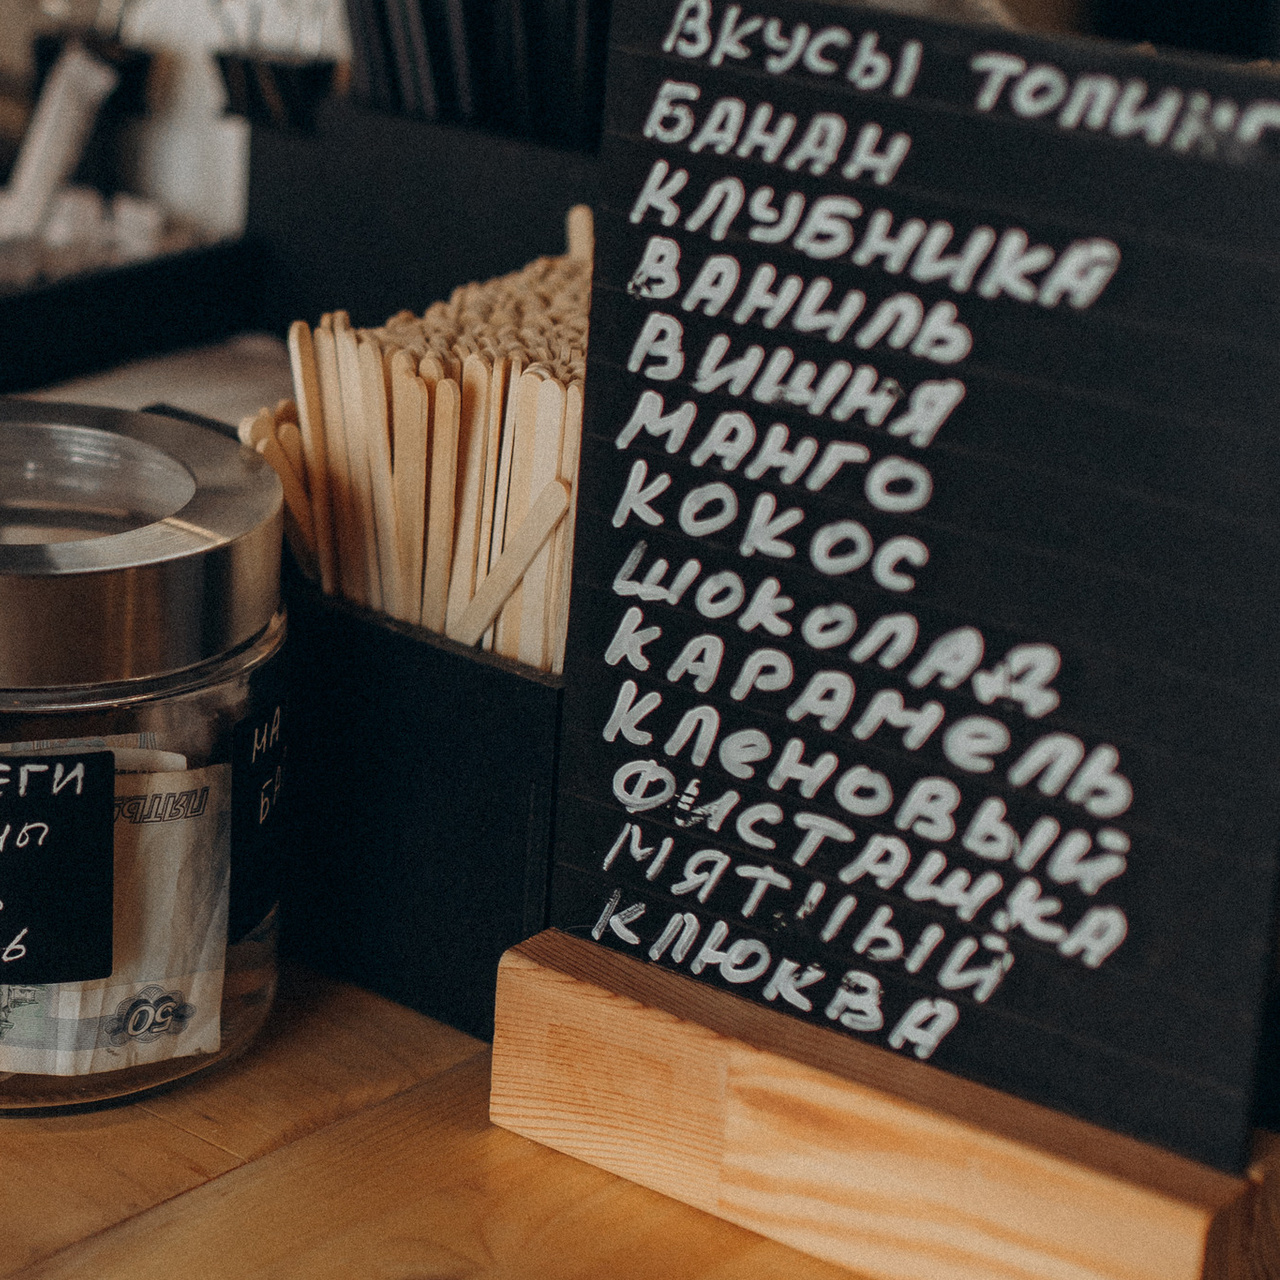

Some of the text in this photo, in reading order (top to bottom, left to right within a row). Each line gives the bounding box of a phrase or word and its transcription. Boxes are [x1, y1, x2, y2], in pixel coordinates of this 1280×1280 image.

[643, 80, 913, 185] БАНАН
[627, 235, 973, 364] ВАНИЛЬ
[629, 159, 1121, 310] КЛУБНИКА
[627, 311, 966, 448] ВИШНЯ
[615, 390, 933, 514] МАНГО
[612, 459, 930, 592] КОКОС
[613, 539, 1062, 719] ШОКОЛАД
[612, 758, 1127, 967] ФИСТАШКА
[125, 998, 178, 1037] 50
[591, 889, 959, 1059] КЛЮКВА
